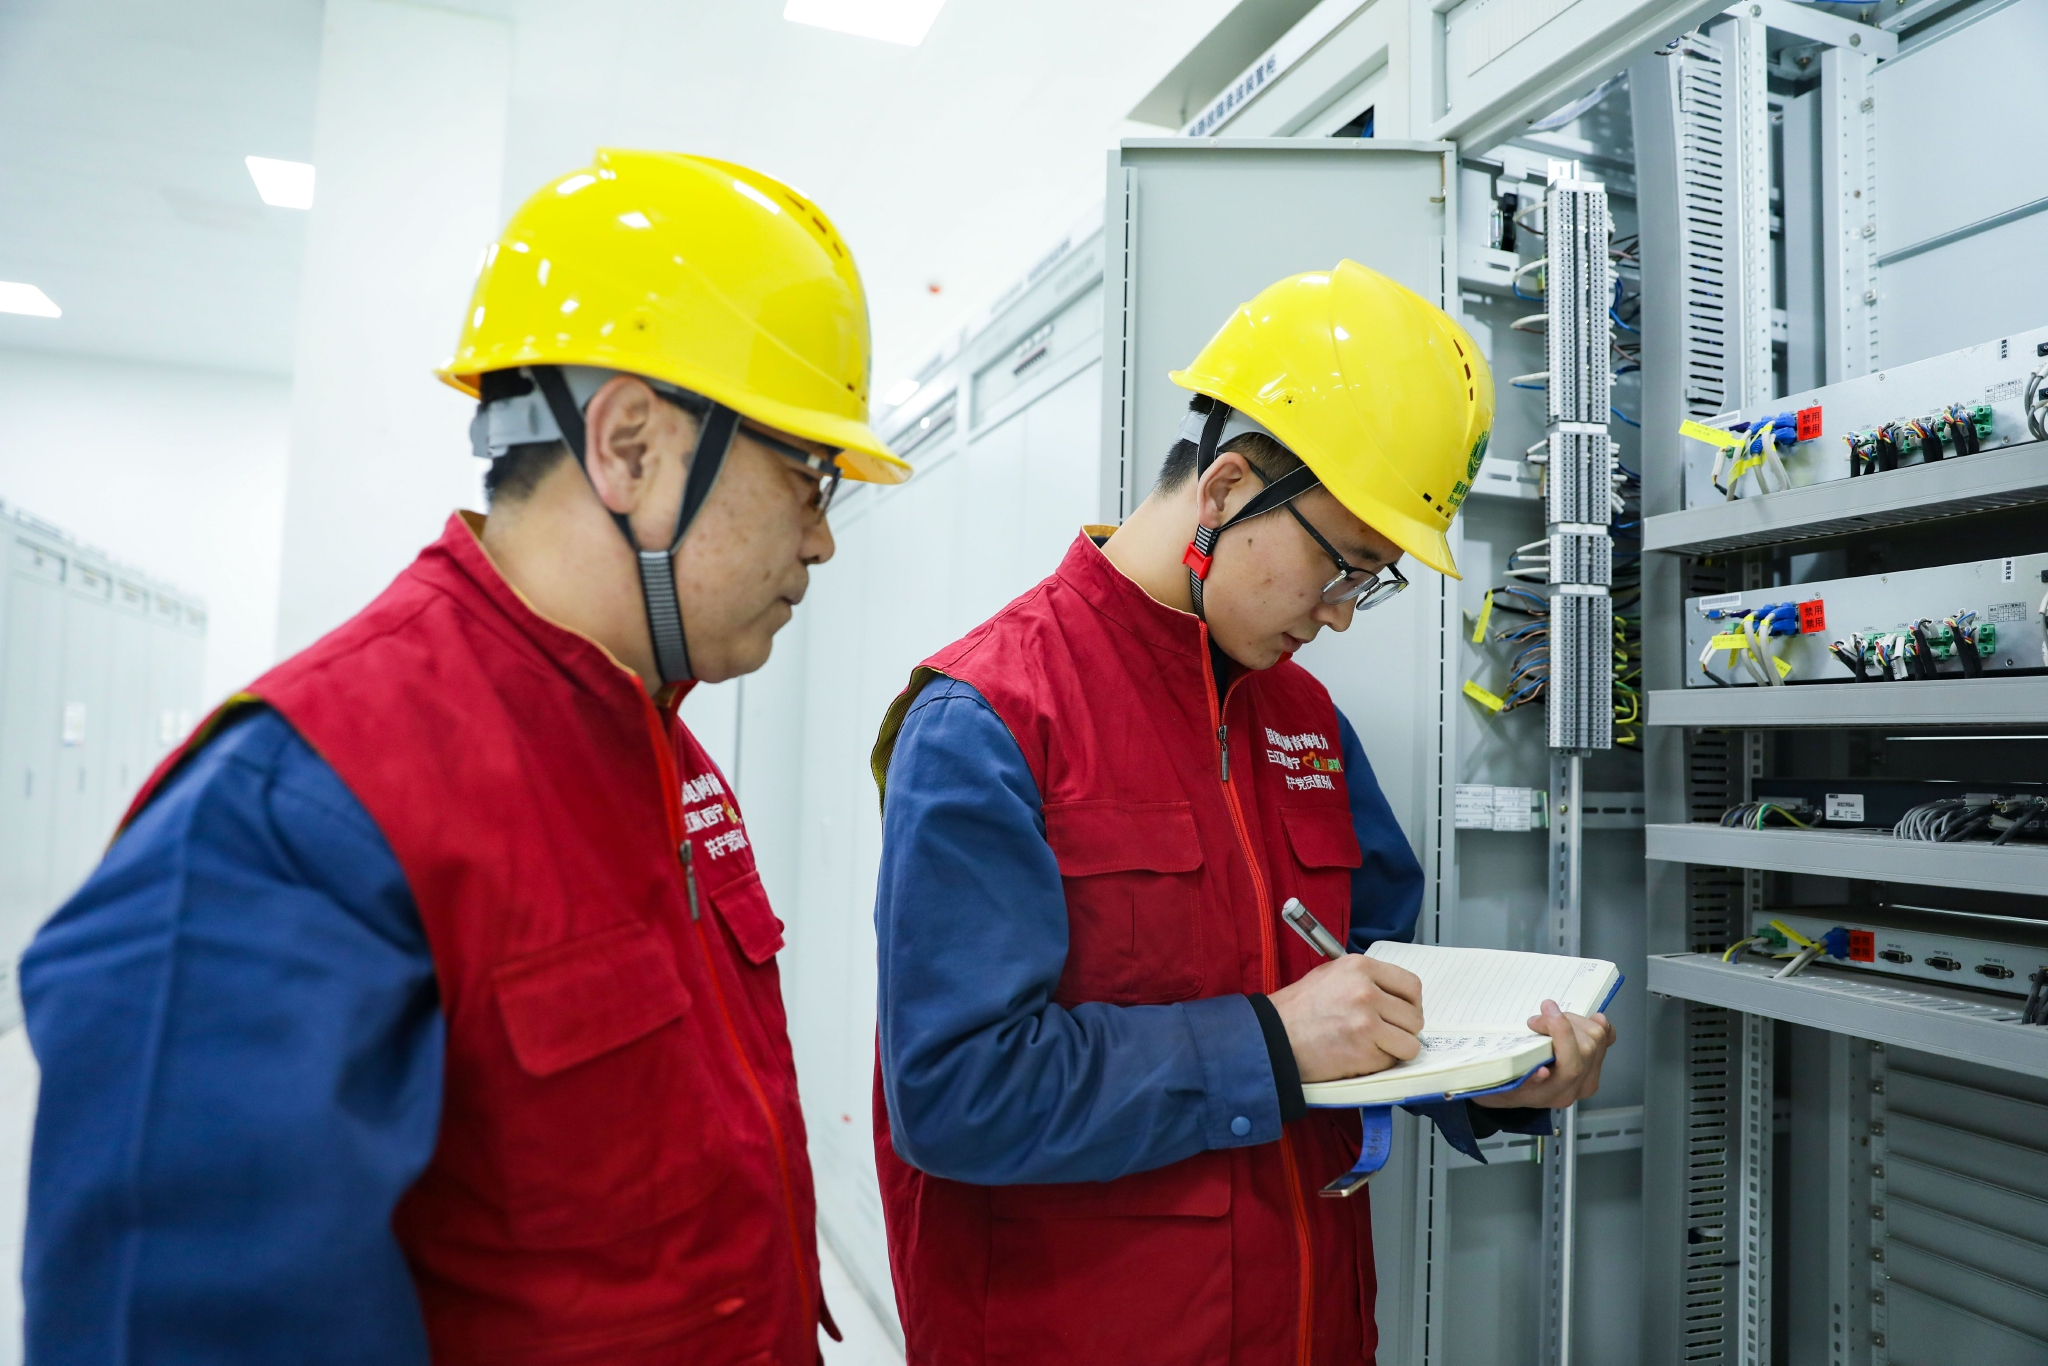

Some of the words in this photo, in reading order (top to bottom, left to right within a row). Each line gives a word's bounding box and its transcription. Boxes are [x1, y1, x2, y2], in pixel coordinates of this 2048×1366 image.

[1802, 411, 1820, 425] 禁用
[1802, 423, 1820, 437] 禁用
[1803, 605, 1824, 618] 禁用
[1804, 616, 1825, 630] 禁用
[1851, 935, 1871, 947] 禁用
[1851, 946, 1871, 960] 禁用
